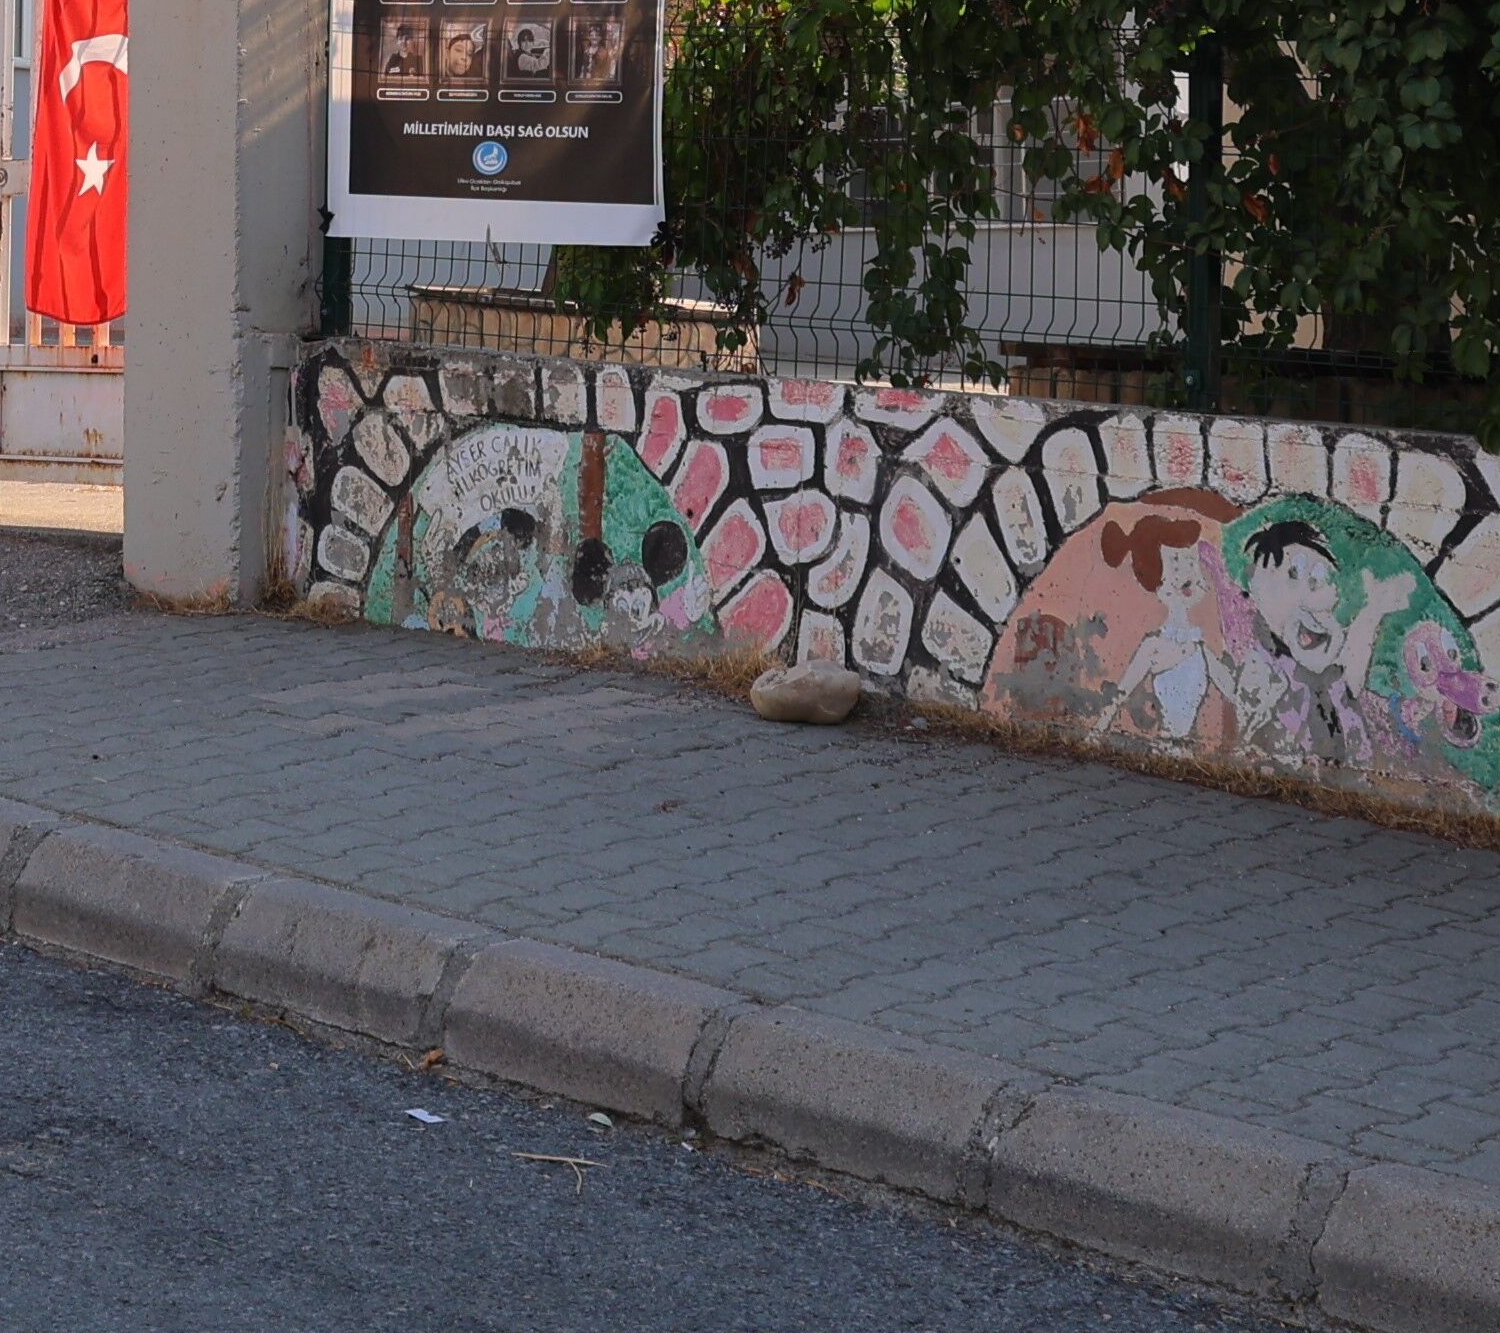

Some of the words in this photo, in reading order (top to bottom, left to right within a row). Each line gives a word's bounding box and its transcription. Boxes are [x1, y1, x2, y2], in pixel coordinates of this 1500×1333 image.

[403, 120, 484, 137] MİLLETİMİZİN
[487, 124, 515, 139] BAŞI
[518, 123, 543, 137] SAĞ
[545, 126, 589, 138] OLSUN
